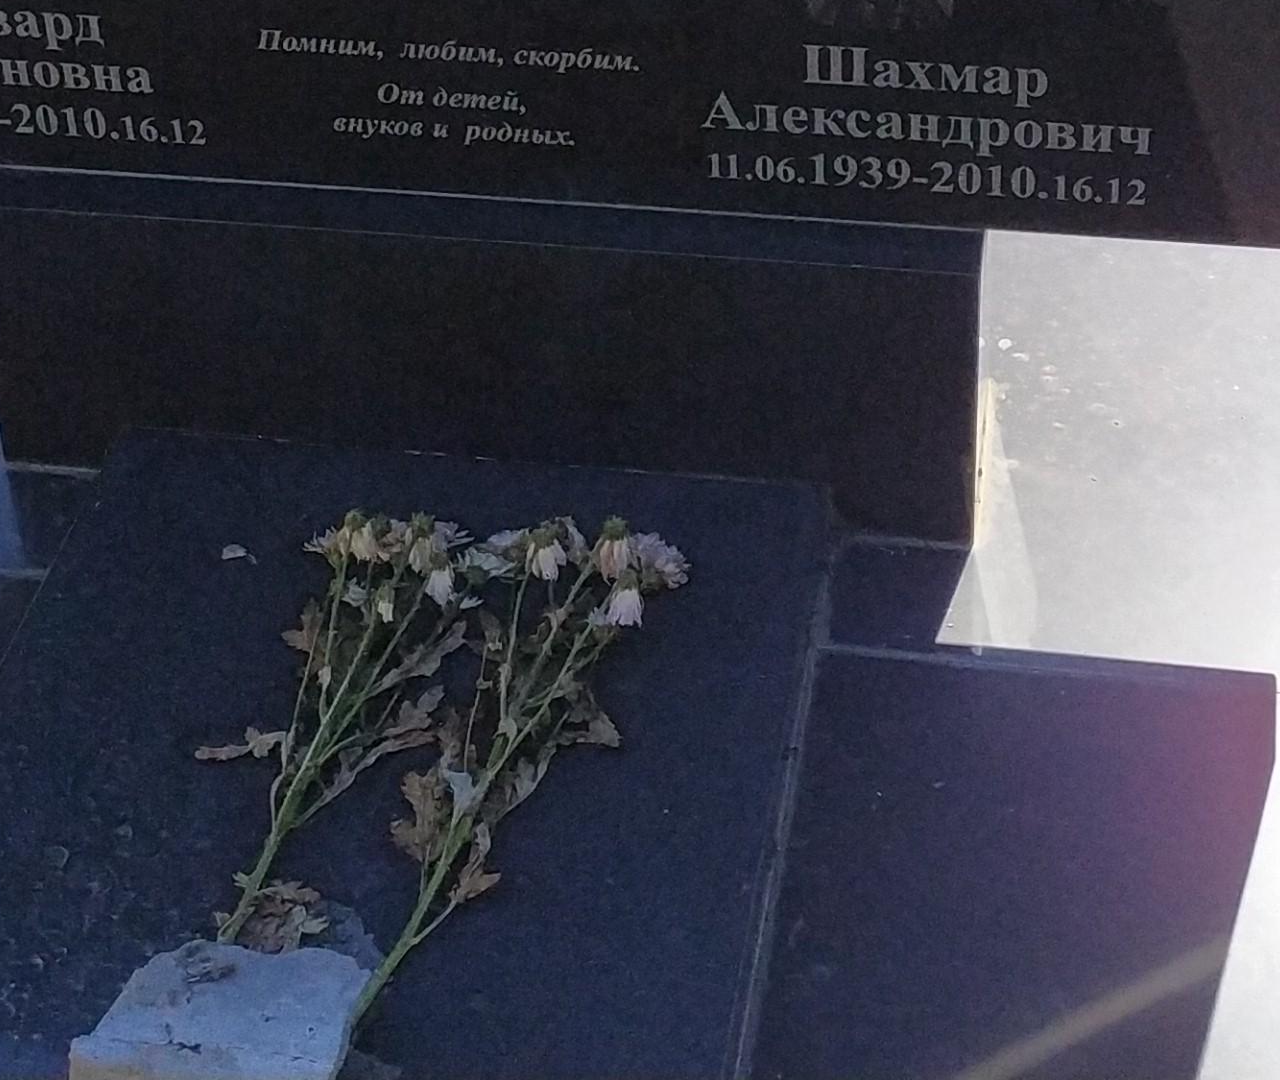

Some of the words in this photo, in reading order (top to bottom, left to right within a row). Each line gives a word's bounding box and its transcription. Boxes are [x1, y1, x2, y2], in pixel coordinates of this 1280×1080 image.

[257, 29, 384, 60] Помним,
[400, 40, 504, 67] любим,
[513, 47, 642, 74] скорбим.
[803, 44, 1048, 108] Шахмар
[377, 83, 424, 107] От
[432, 86, 527, 115] детей,
[333, 115, 423, 139] внуков
[433, 122, 449, 139] и
[464, 122, 576, 147] родных.
[701, 91, 1153, 157] Александрович
[707, 153, 1148, 206] 11.06.1939-2010.16.12
